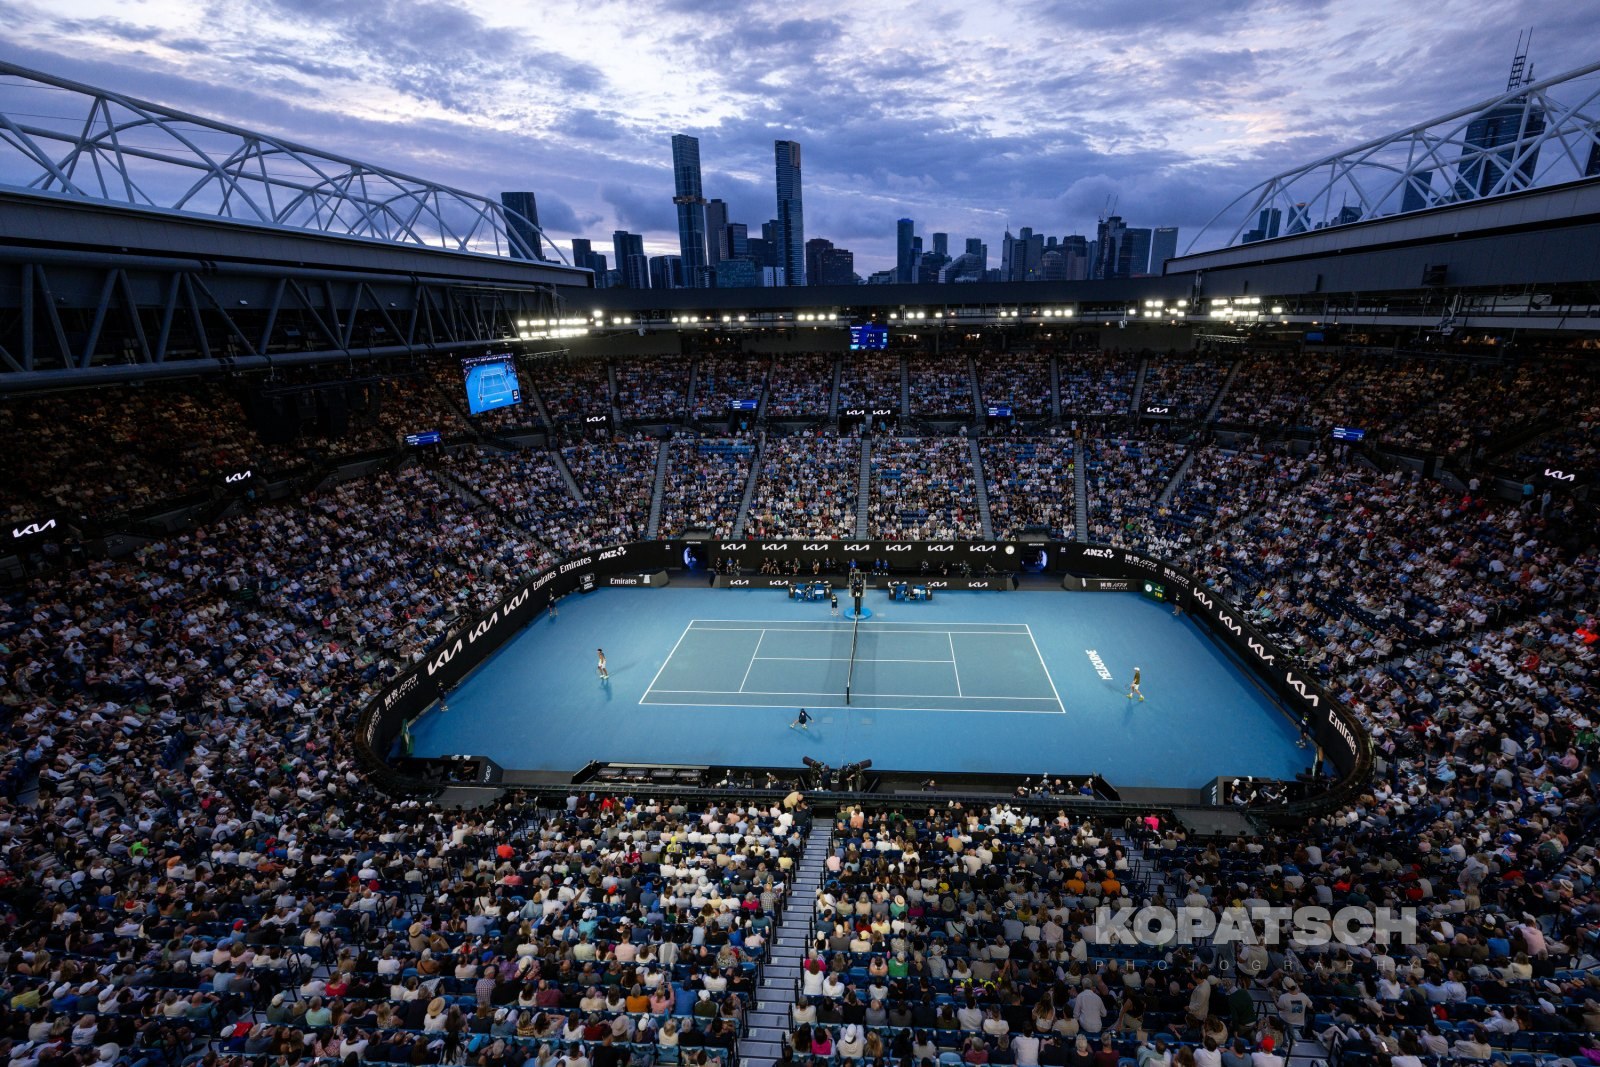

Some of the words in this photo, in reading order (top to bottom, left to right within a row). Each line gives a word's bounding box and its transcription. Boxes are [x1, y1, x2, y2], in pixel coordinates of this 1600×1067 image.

[225, 471, 251, 483] KIA
[1544, 468, 1575, 482] KIA
[12, 519, 56, 538] KIA
[598, 549, 617, 561] ANZ
[1083, 548, 1104, 557] ANZ
[560, 556, 592, 574] Emirates
[533, 570, 557, 591] Emirates
[610, 577, 637, 585] Emirates
[503, 588, 529, 616] KIA
[1193, 587, 1213, 610] KIA
[468, 611, 498, 643] KIA
[1219, 611, 1241, 635] KIA
[427, 638, 463, 676] KIA
[1248, 637, 1275, 666] KIA
[1286, 672, 1319, 707] KIA
[1328, 708, 1356, 755] Emirates
